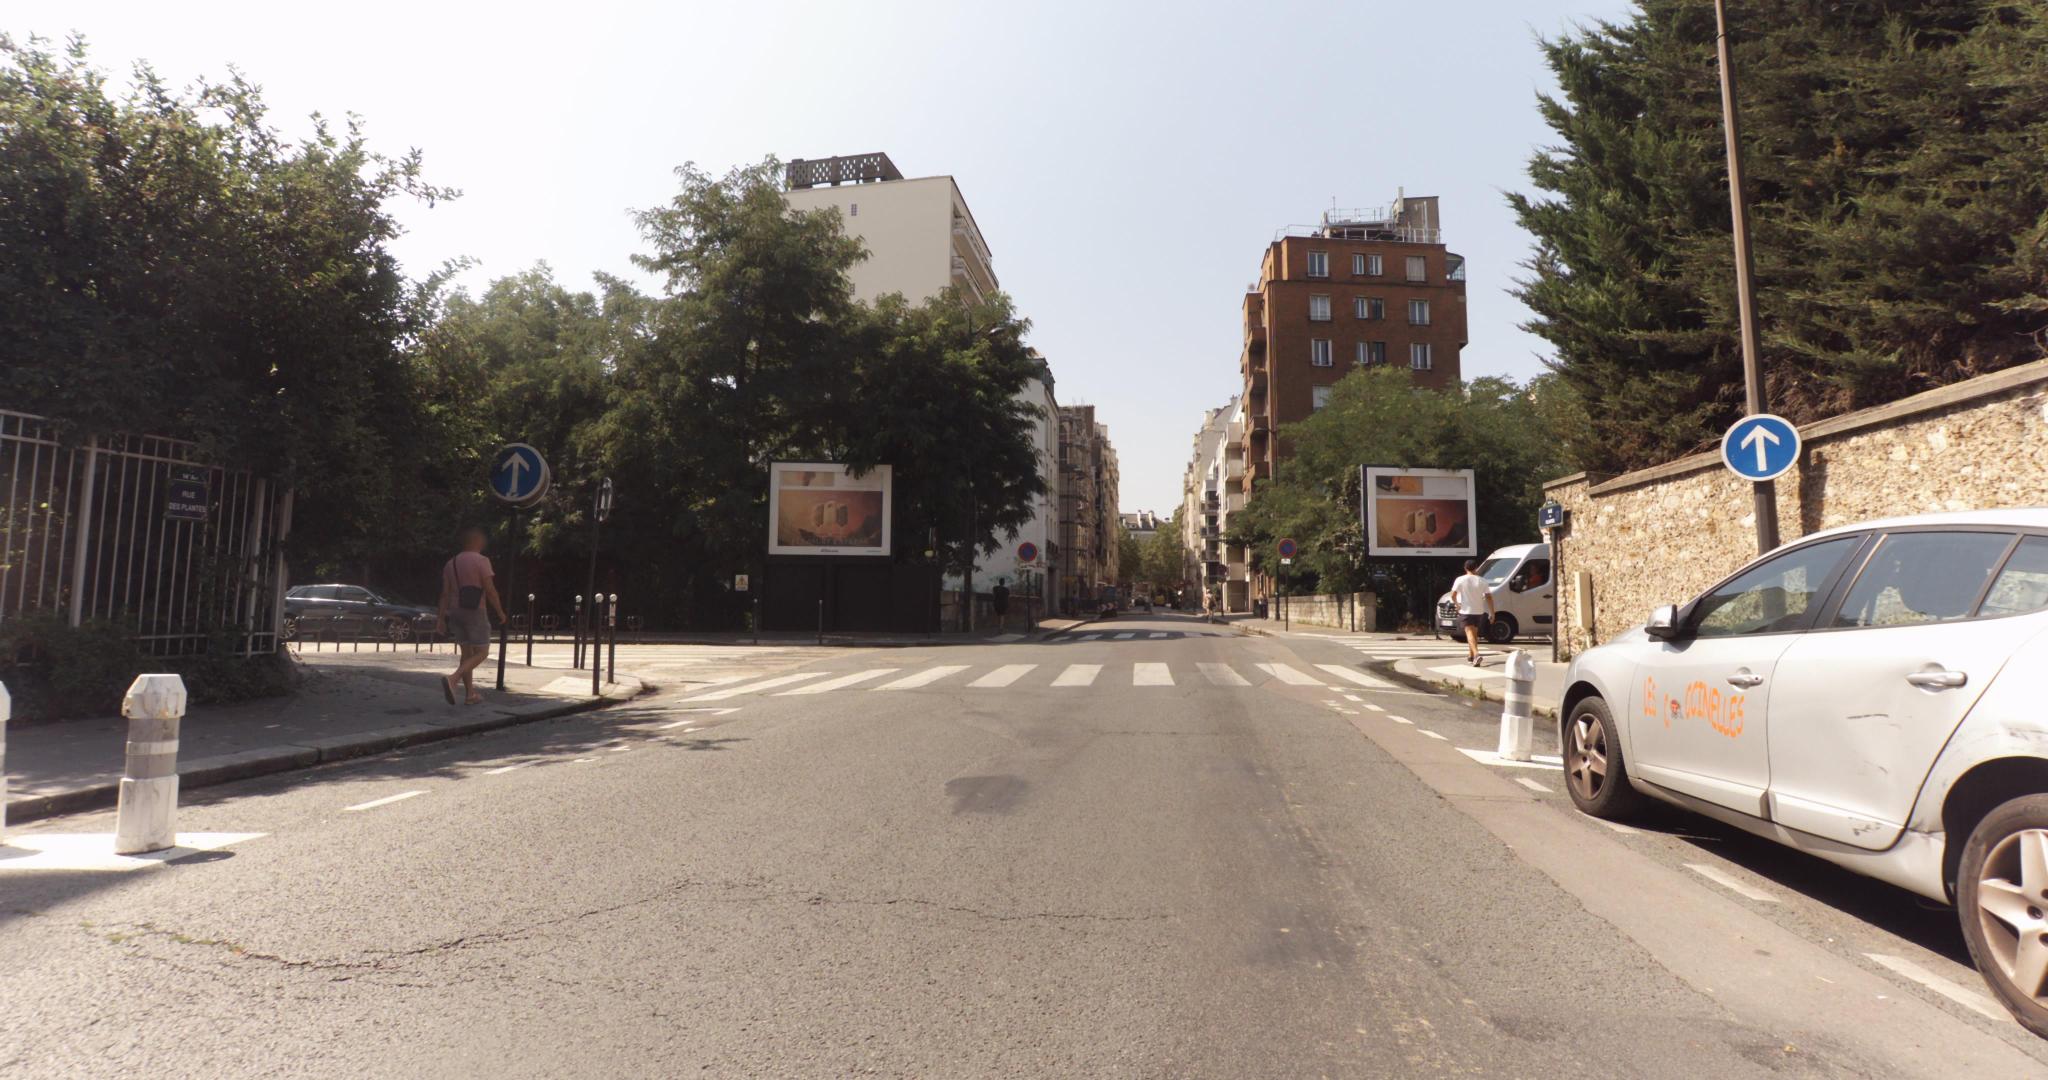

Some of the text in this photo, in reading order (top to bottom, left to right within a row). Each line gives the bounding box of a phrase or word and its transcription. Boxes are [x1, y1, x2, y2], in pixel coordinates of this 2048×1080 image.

[182, 490, 195, 499] RUE
[169, 502, 180, 510] DES
[1643, 675, 1657, 717] LES
